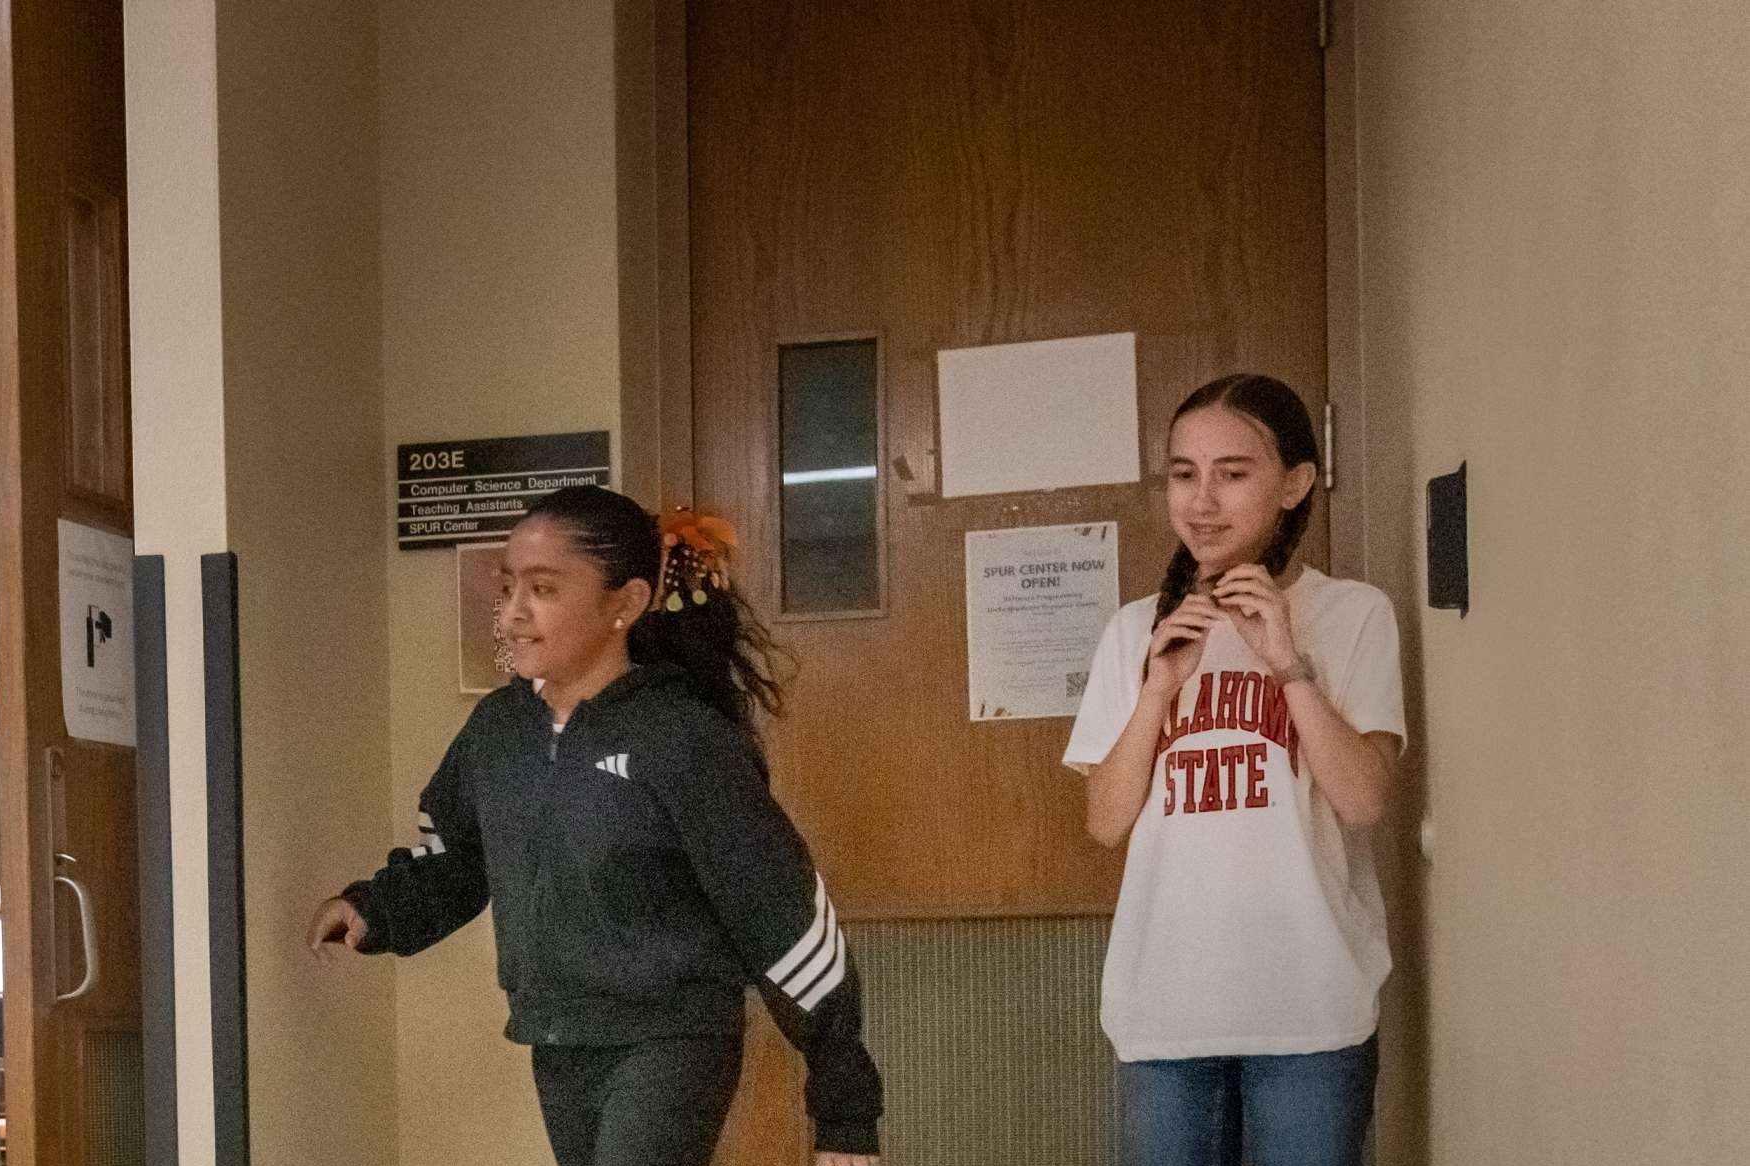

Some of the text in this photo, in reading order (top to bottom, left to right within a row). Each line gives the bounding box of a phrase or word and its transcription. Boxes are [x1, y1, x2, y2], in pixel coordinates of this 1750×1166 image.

[409, 450, 465, 471] 203E
[410, 474, 597, 497] Computer Science Department
[410, 498, 524, 516] Teaching Assistants
[409, 519, 479, 534] SPUR Center
[983, 559, 1106, 579] SPUR CENTER NOW
[1021, 576, 1060, 590] OPEN!
[1164, 743, 1269, 816] STATE
